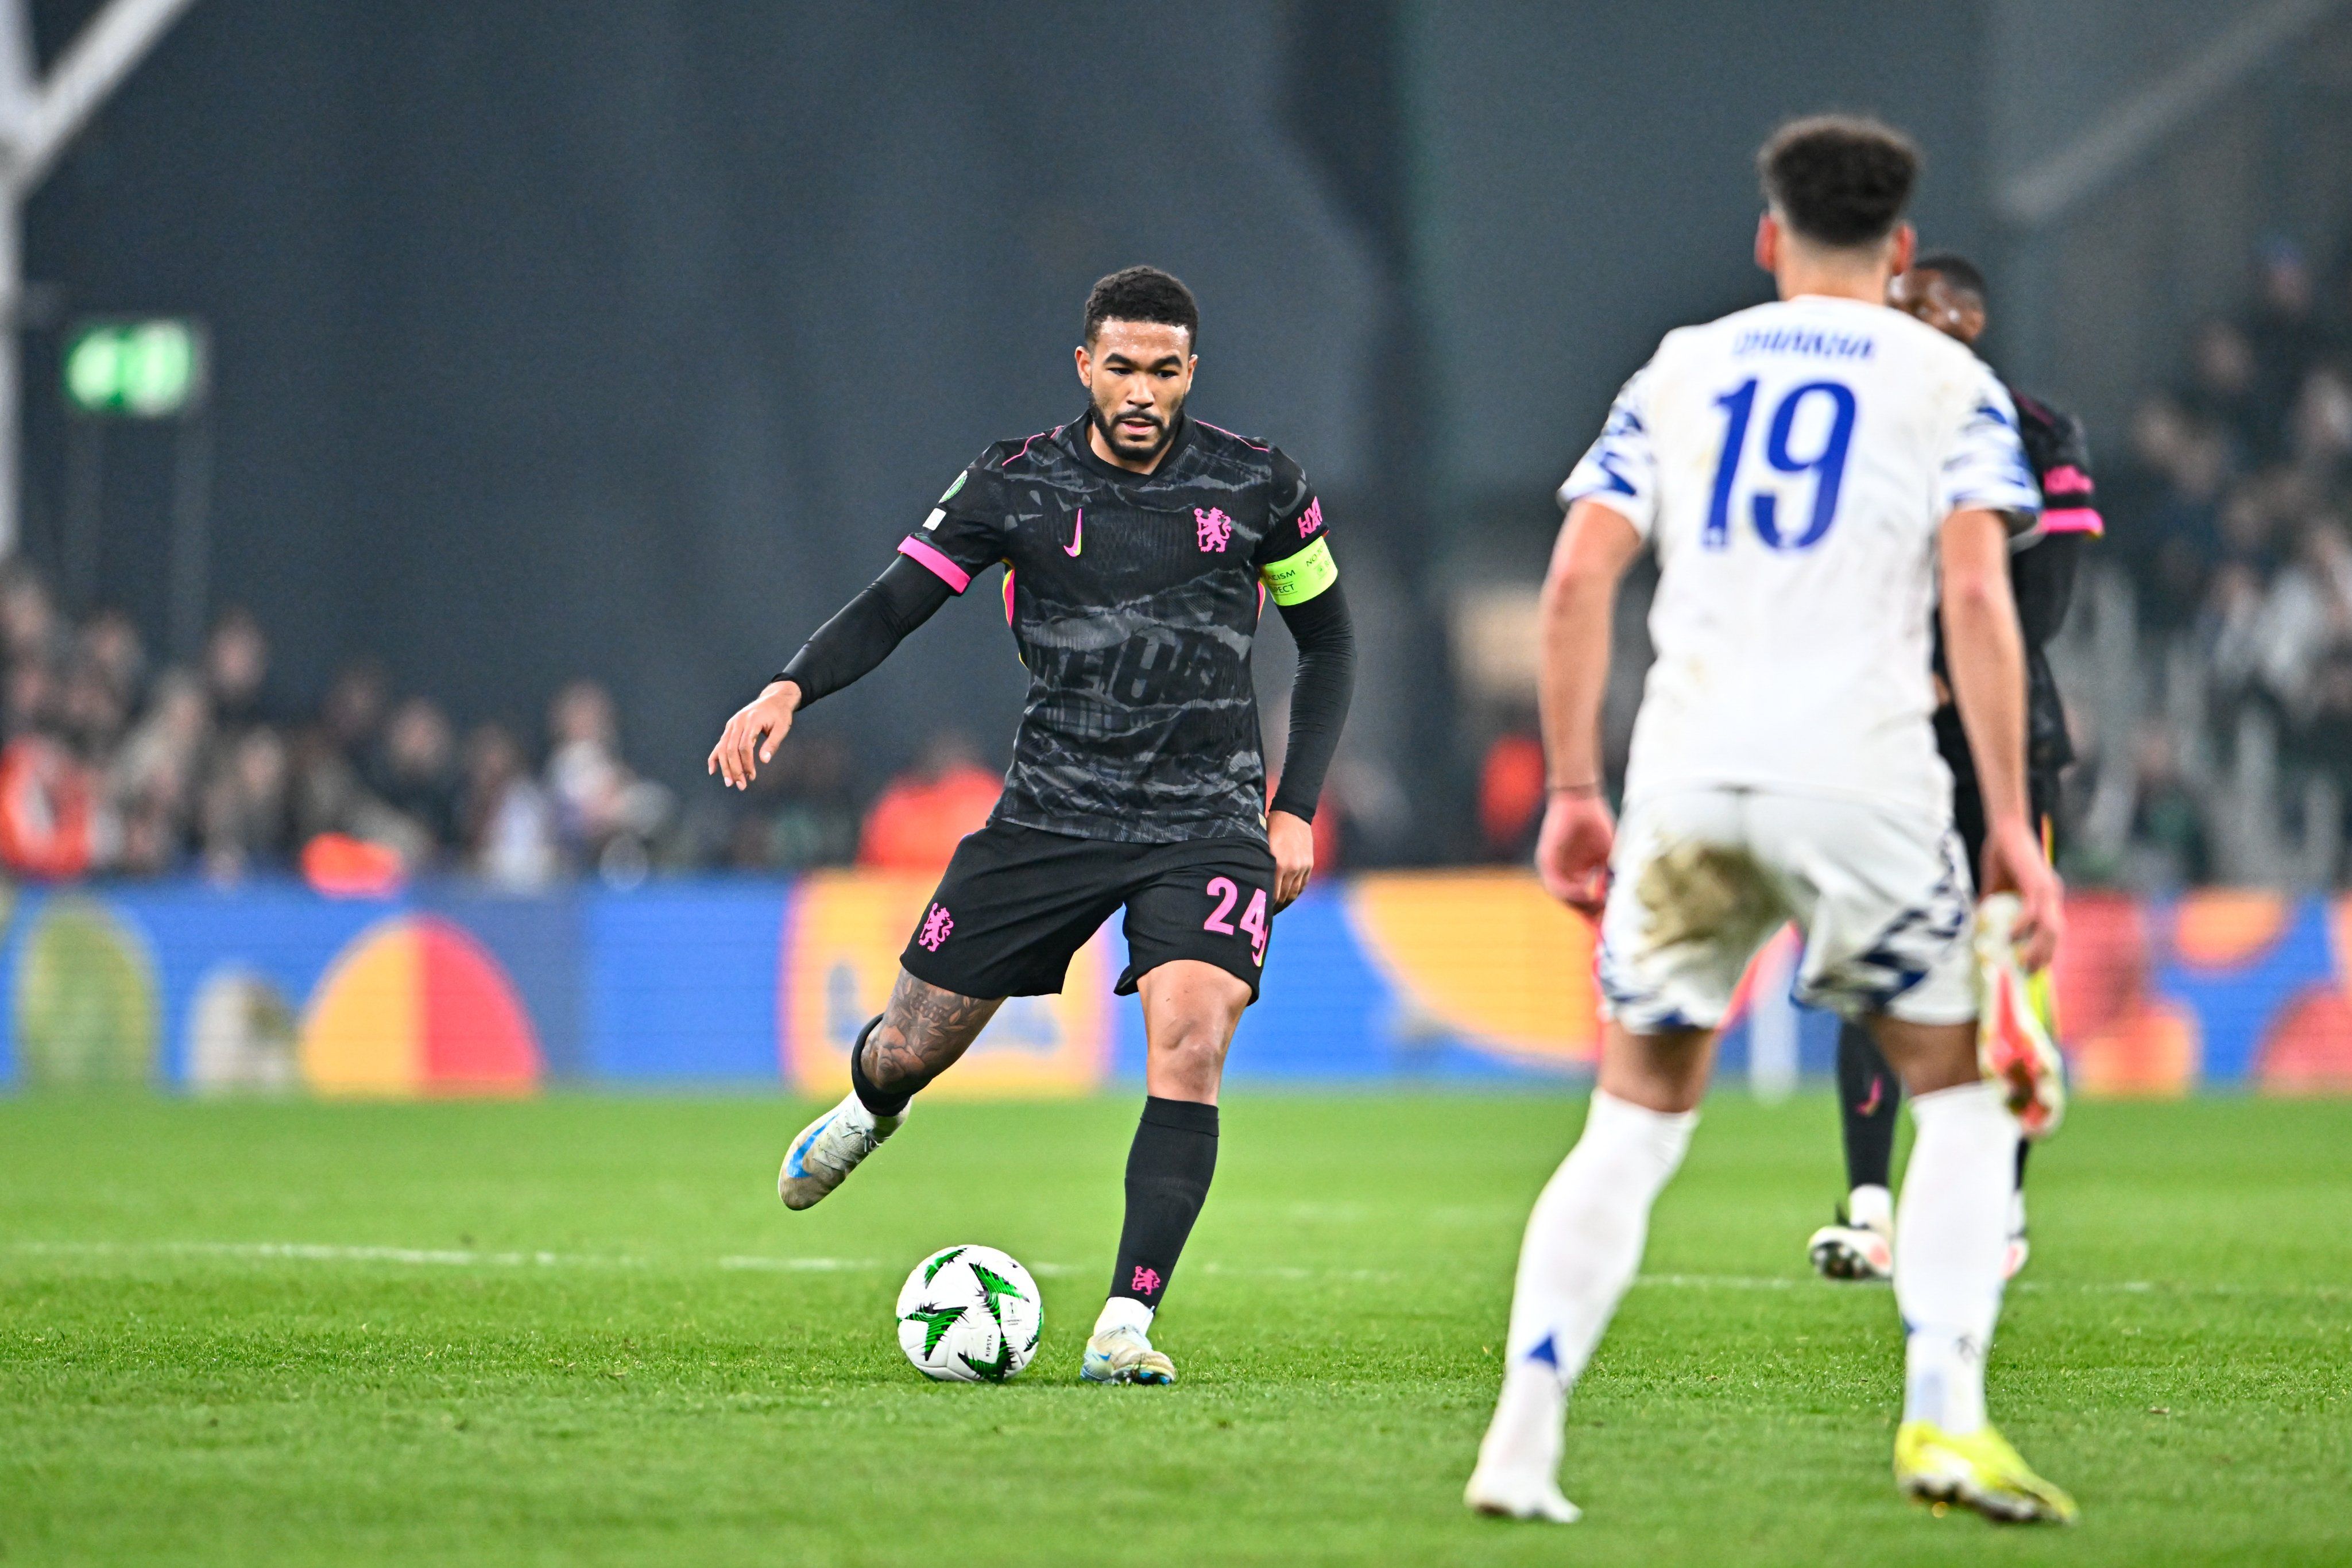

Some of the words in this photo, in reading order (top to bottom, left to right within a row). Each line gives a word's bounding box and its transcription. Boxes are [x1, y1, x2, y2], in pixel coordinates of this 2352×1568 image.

[1703, 378, 1856, 548] 19
[1266, 570, 1296, 580] ACISM
[1306, 553, 1317, 567] NO
[1204, 877, 1267, 949] 24
